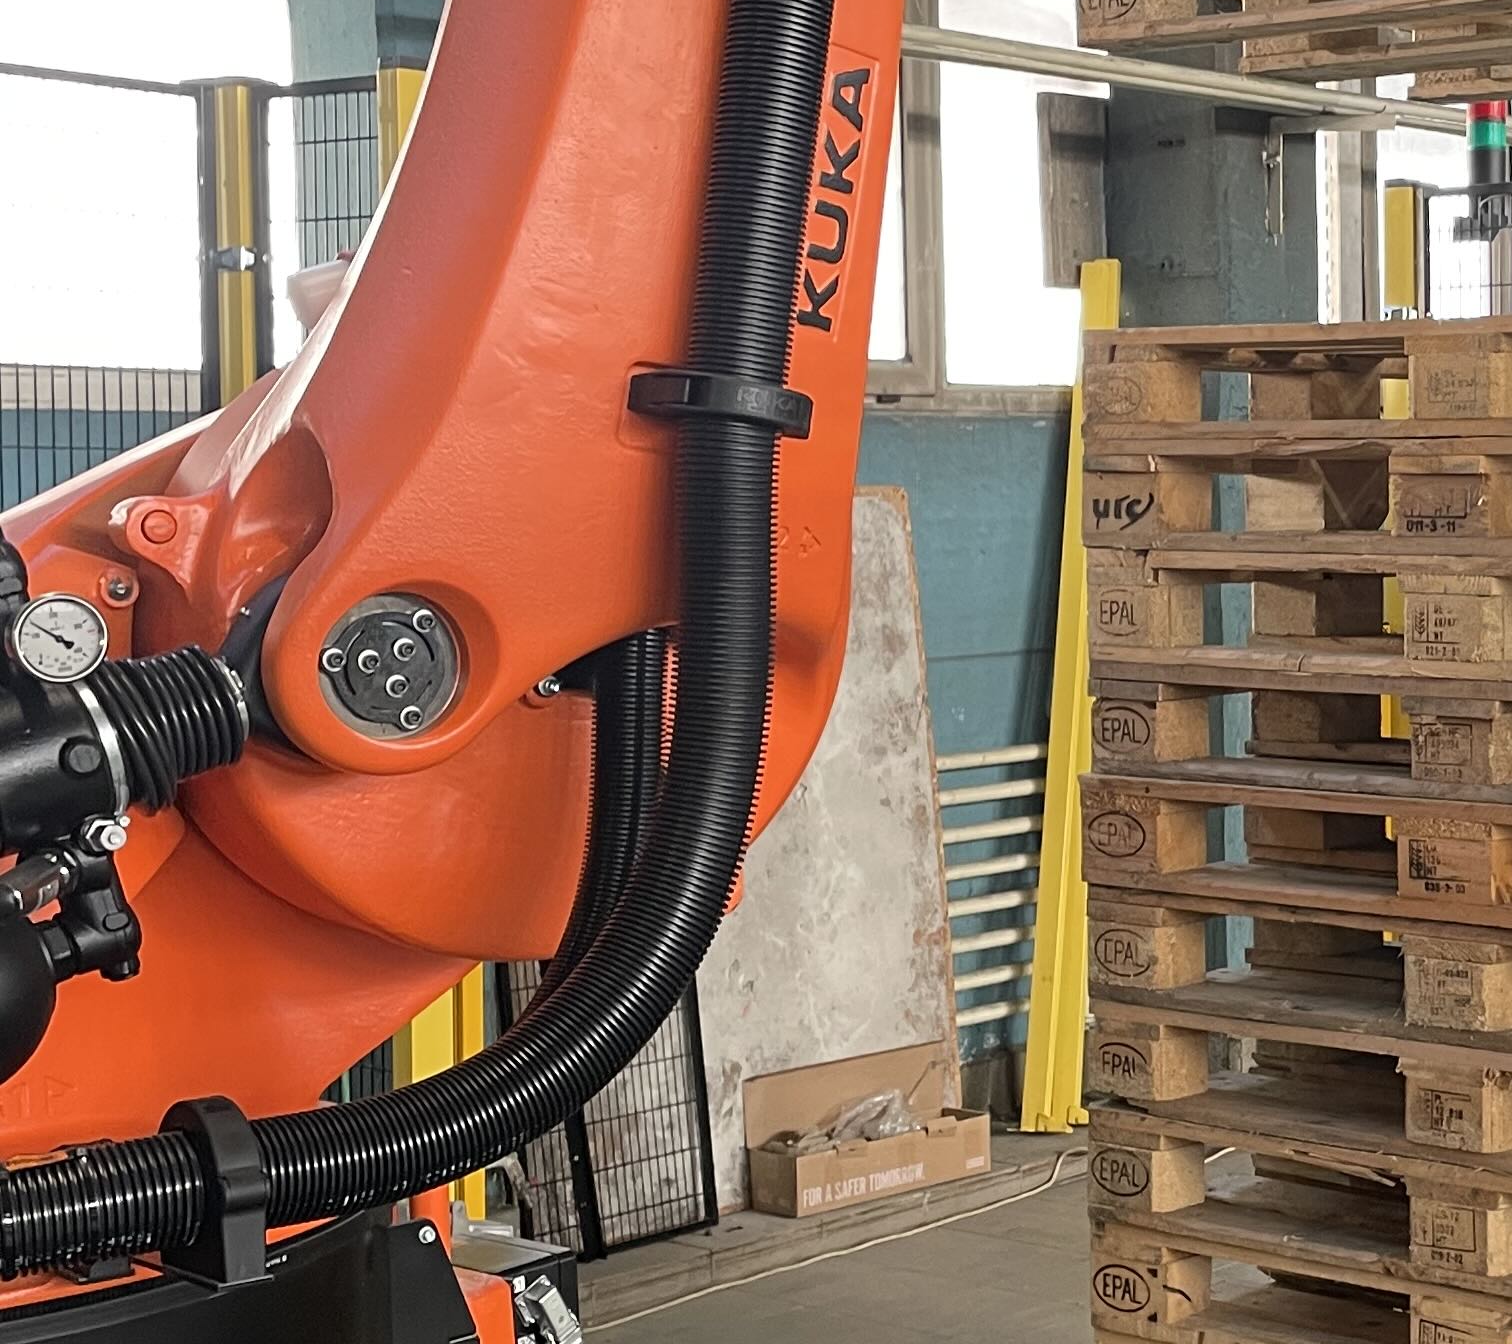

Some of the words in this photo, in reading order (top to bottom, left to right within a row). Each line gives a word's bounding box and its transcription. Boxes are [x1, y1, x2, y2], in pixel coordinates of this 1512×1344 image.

[797, 68, 870, 333] KUKA
[1099, 599, 1137, 627] EPAL
[1101, 715, 1141, 745] EPAL
[1100, 1160, 1140, 1188] EPAL
[802, 1186, 823, 1209] FOR
[824, 1185, 833, 1204] A
[834, 1176, 867, 1201] SAFER
[1102, 1273, 1140, 1304] EPAL
